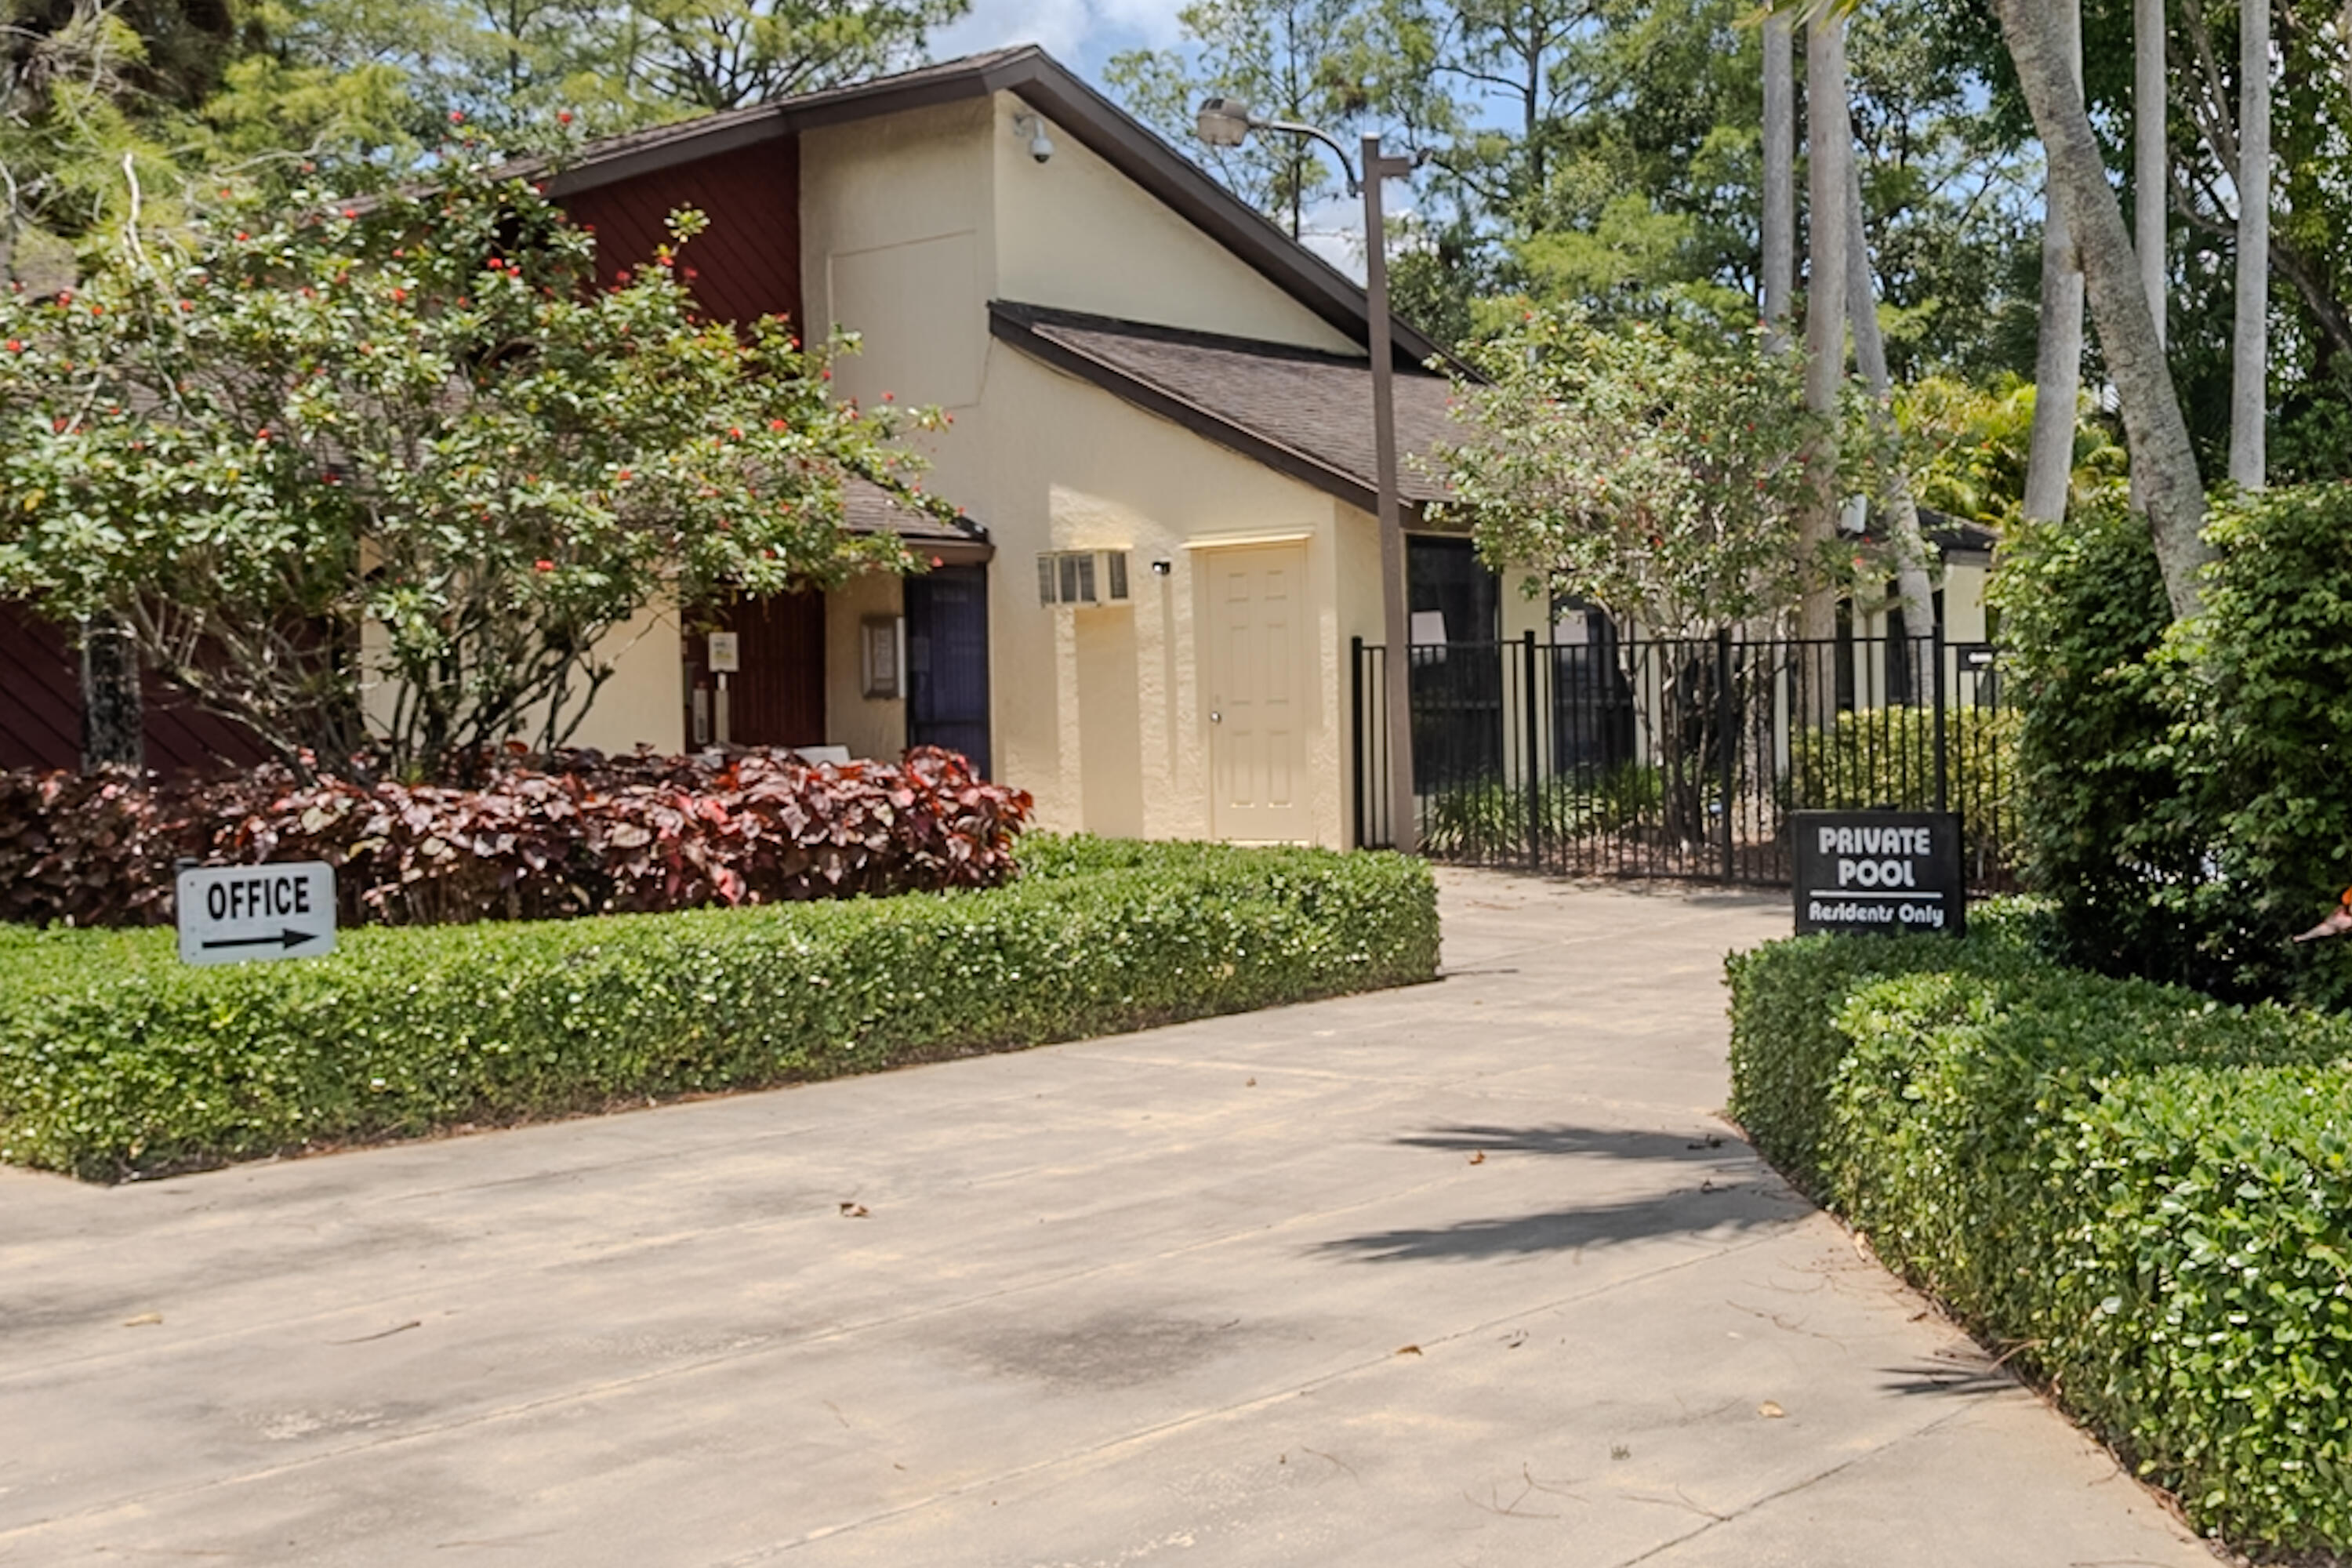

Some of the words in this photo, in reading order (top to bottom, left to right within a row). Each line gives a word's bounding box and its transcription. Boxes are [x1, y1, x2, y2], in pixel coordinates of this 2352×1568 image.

[1818, 827, 1931, 855] PRIVATE
[1838, 859, 1915, 887] POOL
[207, 876, 310, 921] OFFICE
[1809, 902, 1894, 923] Residents
[1898, 903, 1944, 927] Only
